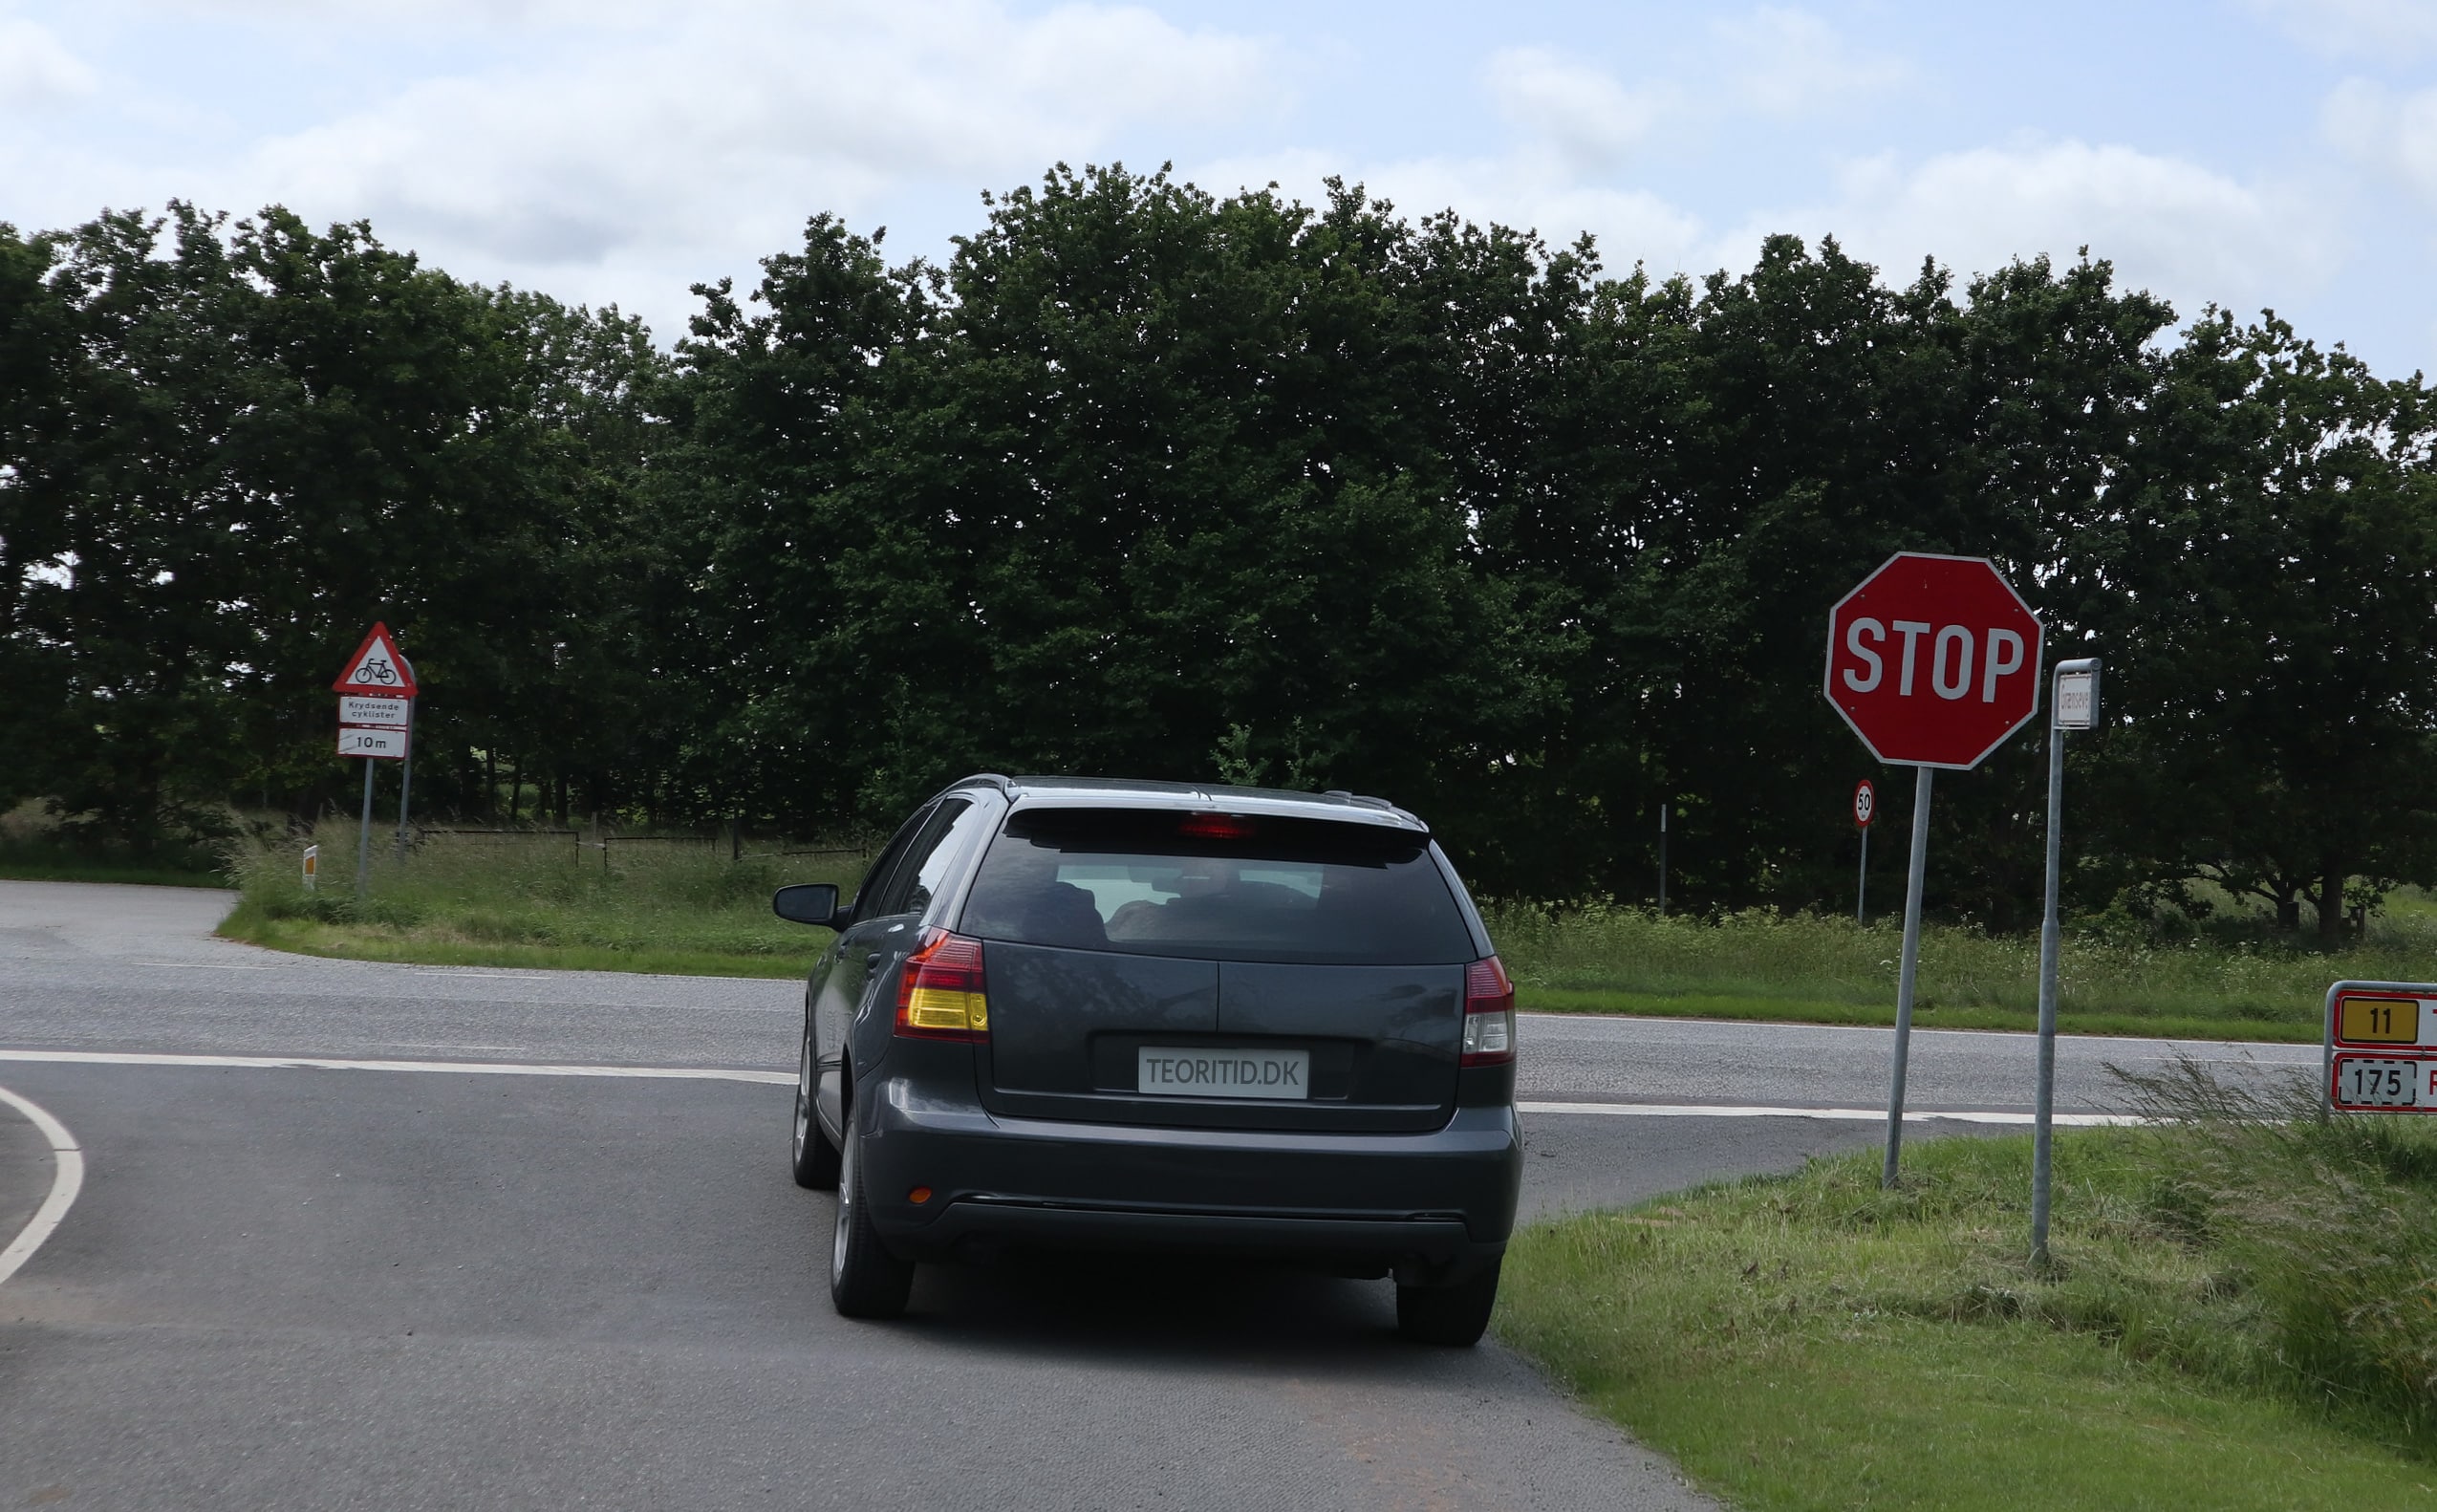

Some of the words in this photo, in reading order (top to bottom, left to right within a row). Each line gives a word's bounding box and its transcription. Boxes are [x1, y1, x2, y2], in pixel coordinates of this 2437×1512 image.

[1843, 617, 2024, 702] STOP
[349, 701, 399, 711] Krydsende
[352, 710, 396, 719] cyklister
[1858, 793, 1871, 810] 50
[2370, 1007, 2391, 1034] 11
[1146, 1058, 1300, 1086] TEORITID.DK
[2355, 1069, 2401, 1096] 175
